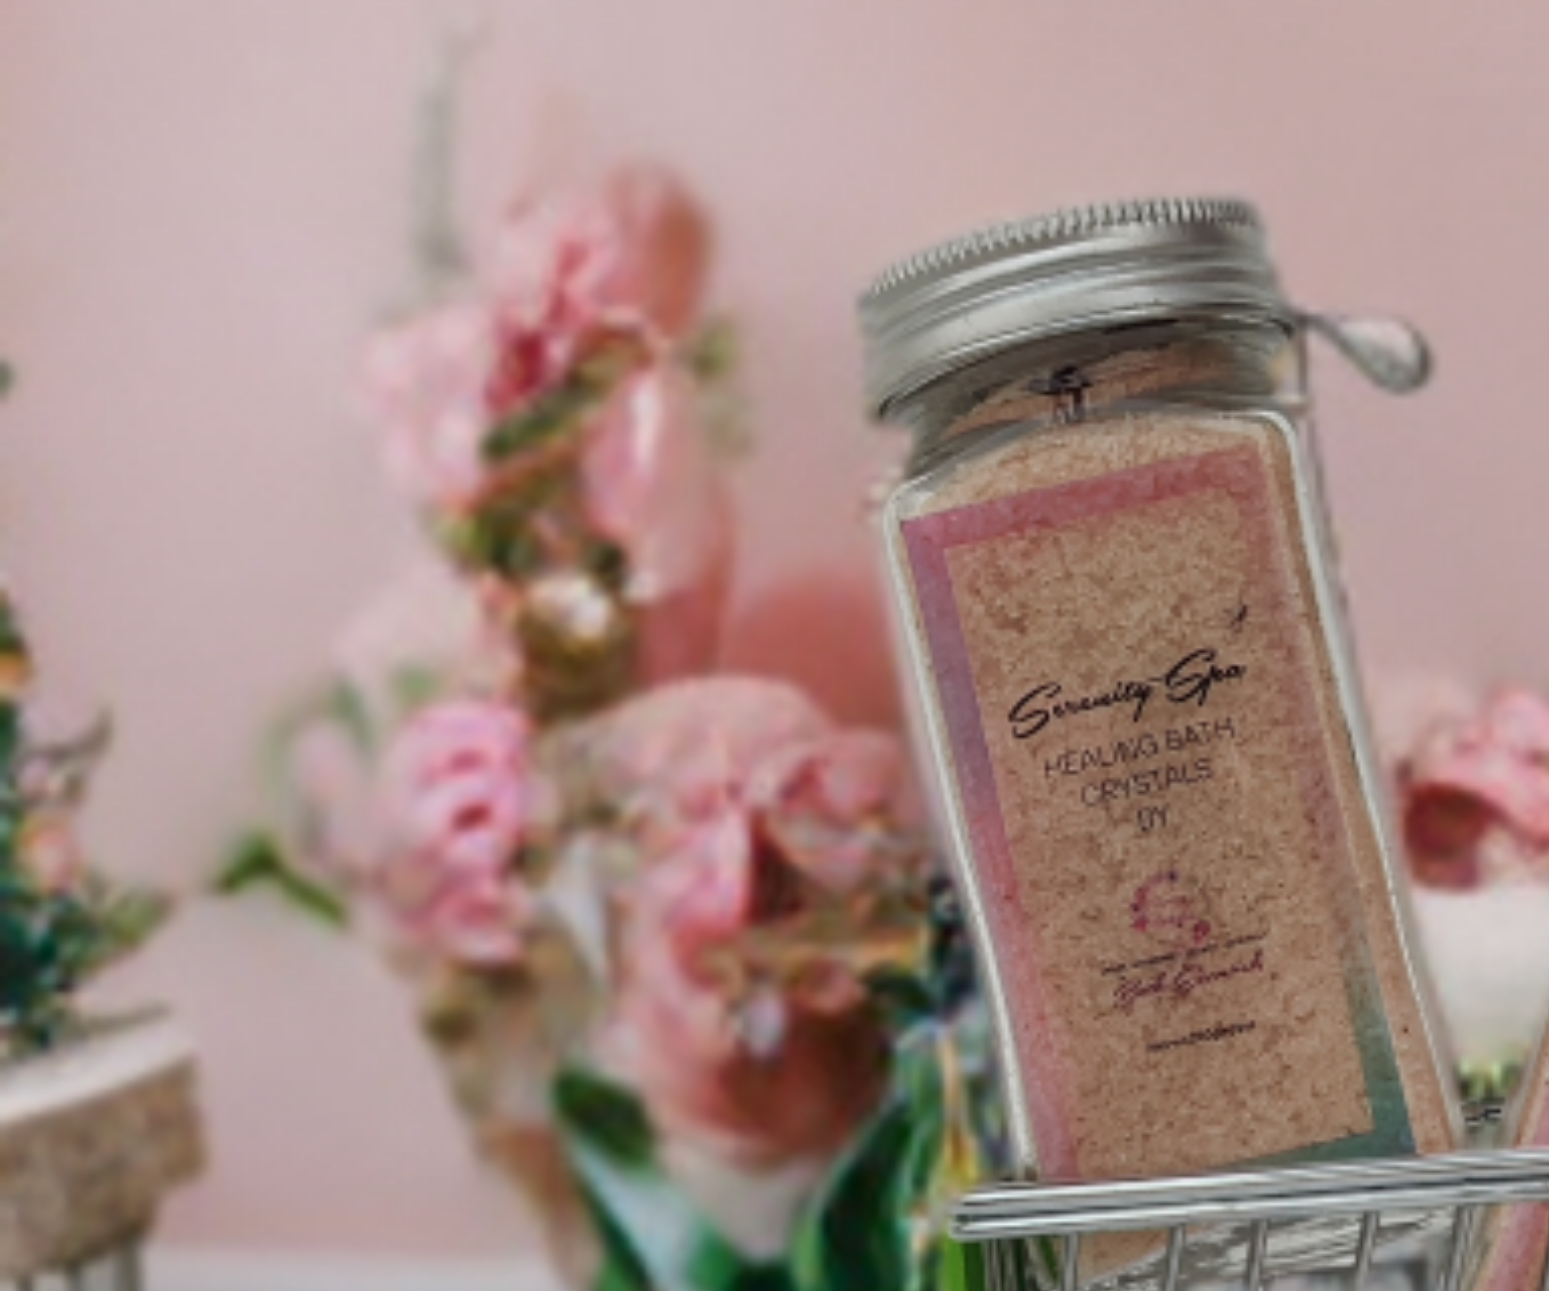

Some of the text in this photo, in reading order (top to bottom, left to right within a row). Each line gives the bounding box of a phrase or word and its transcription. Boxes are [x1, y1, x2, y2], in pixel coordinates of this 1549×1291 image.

[1008, 648, 1246, 739] Serenity Spa
[1044, 717, 1235, 779] HEALING BATH
[1081, 758, 1214, 807] CRYSTALS
